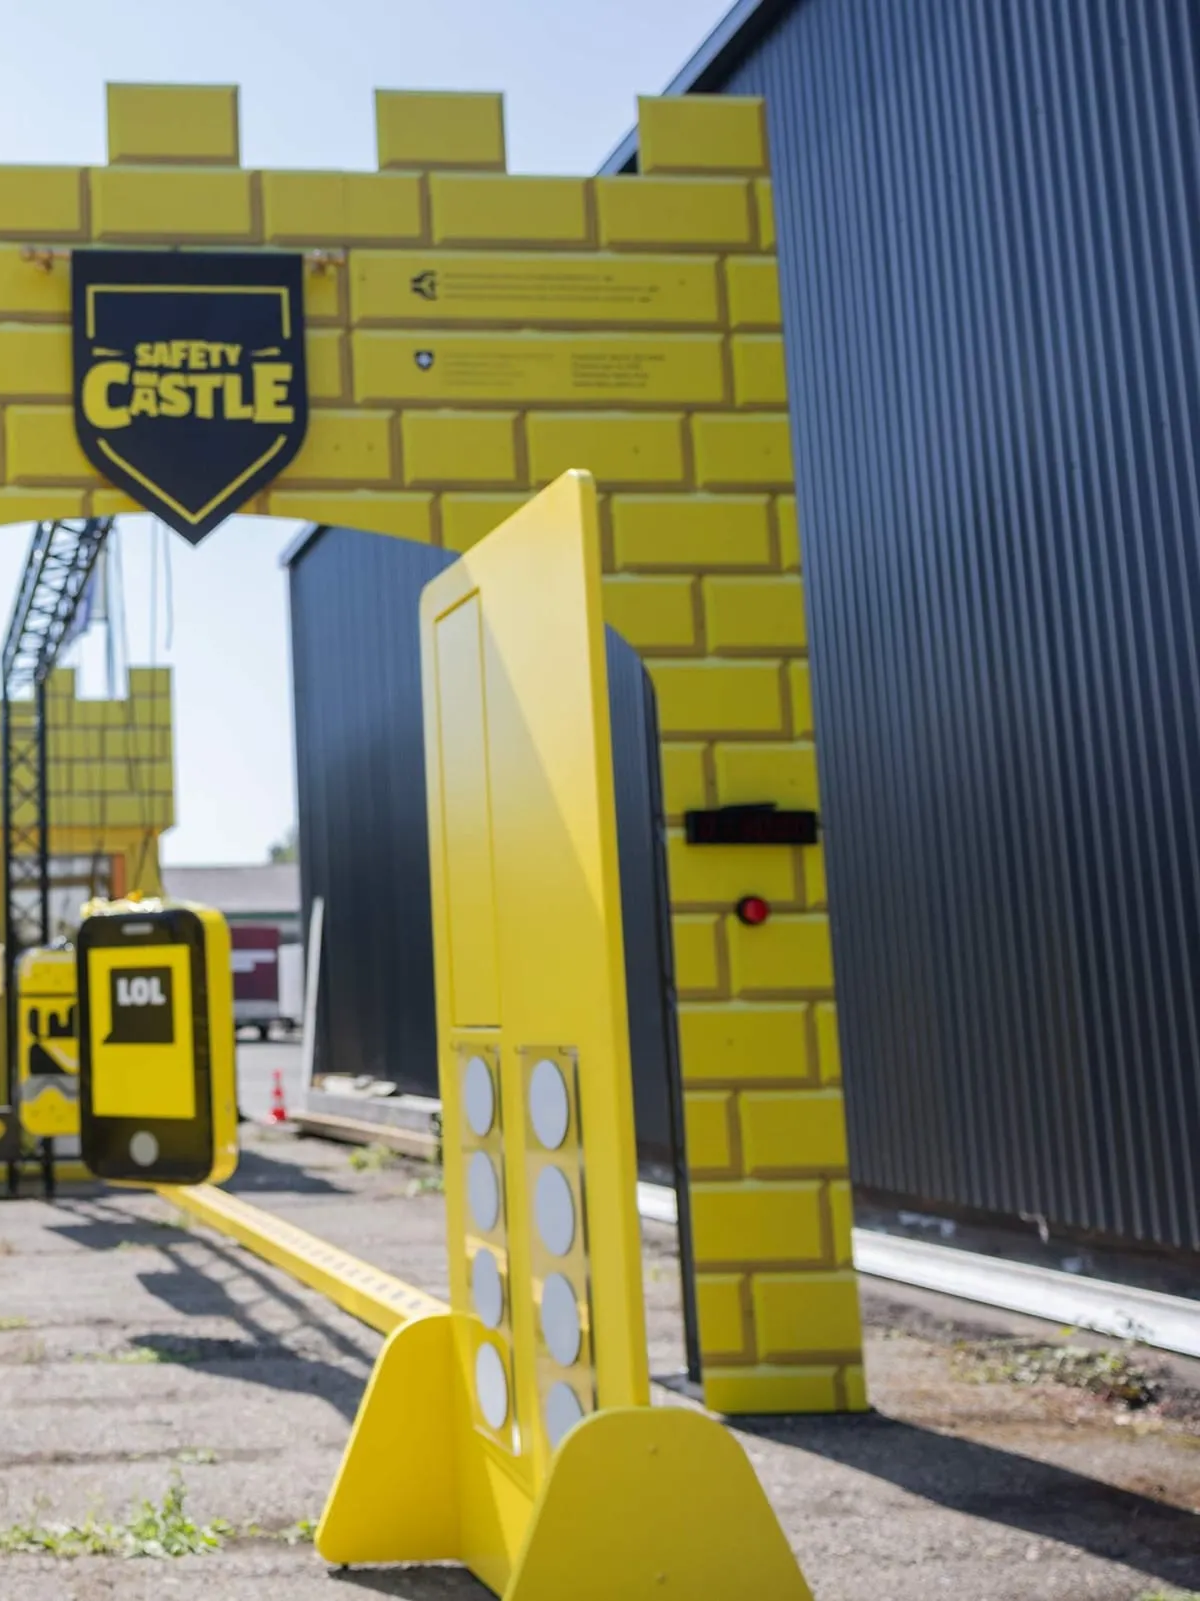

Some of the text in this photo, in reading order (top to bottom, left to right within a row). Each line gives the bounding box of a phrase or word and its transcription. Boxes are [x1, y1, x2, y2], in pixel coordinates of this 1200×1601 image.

[135, 340, 241, 369] SAFETY
[83, 359, 293, 429] CASTLE
[117, 977, 165, 1005] LOL
